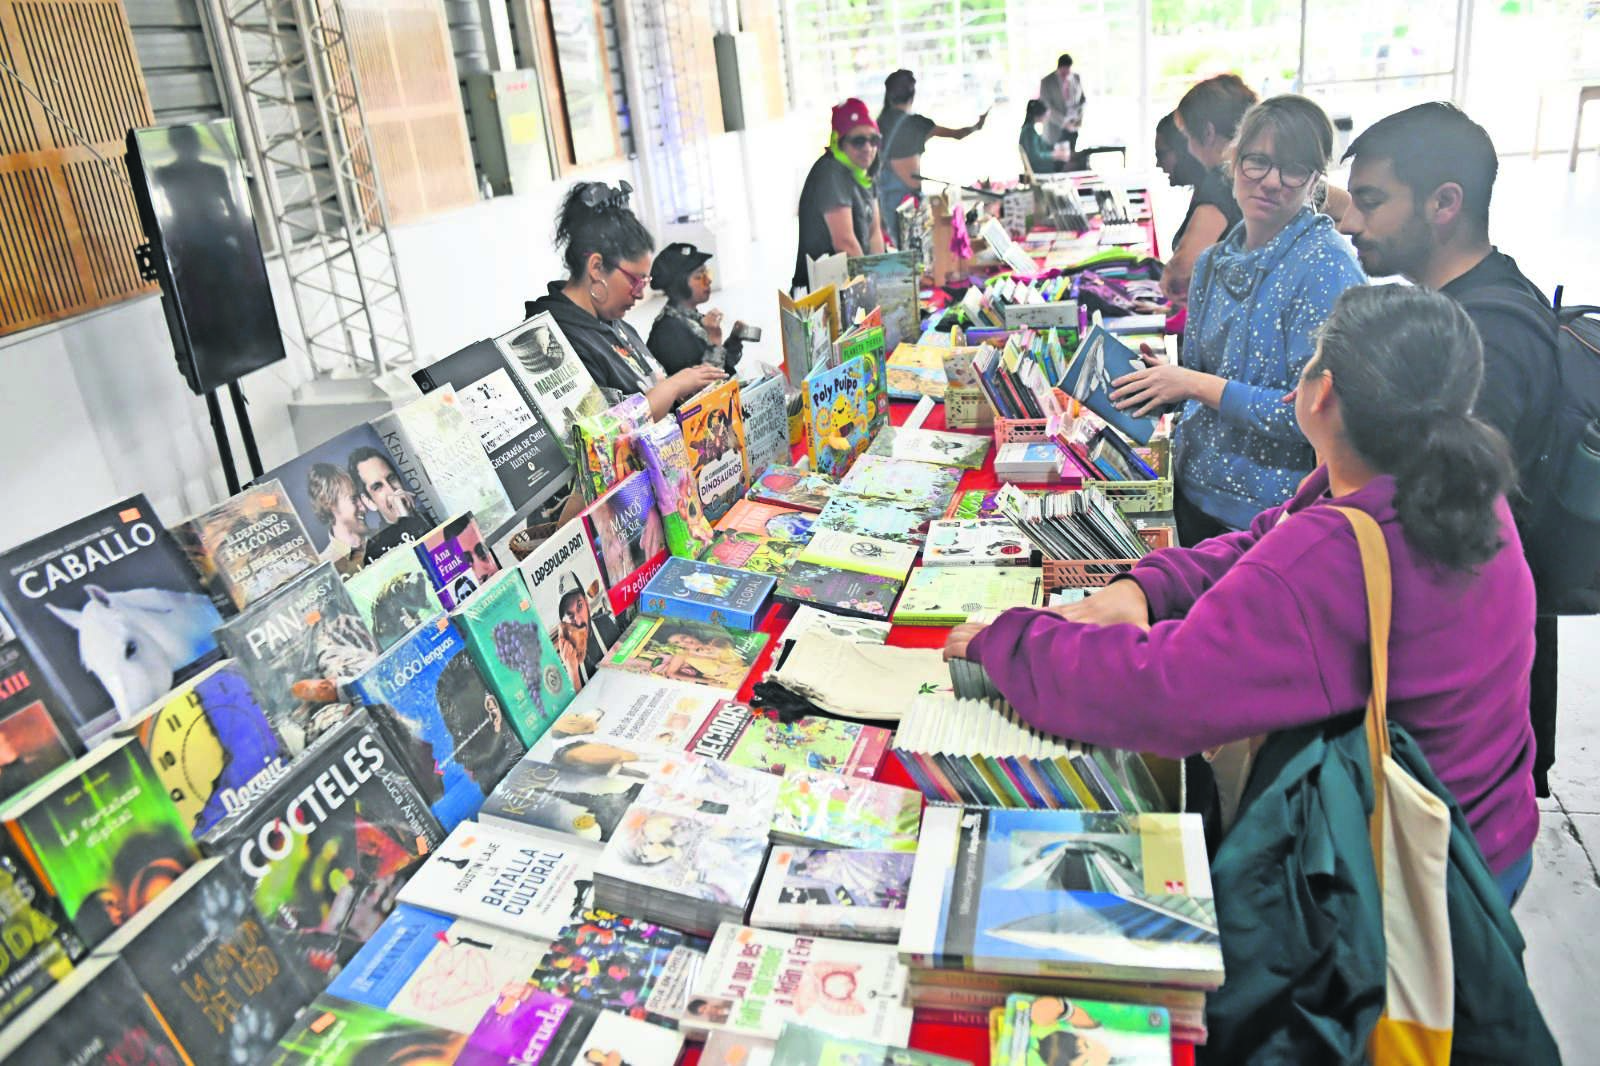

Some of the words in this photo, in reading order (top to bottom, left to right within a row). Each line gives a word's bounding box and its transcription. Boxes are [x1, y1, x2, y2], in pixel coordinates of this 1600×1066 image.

[534, 360, 581, 396] MARAVILLAS
[813, 383, 833, 407] Poly
[834, 376, 858, 394] Pulpo
[383, 431, 408, 467] KEN
[700, 460, 742, 497] DINOSAURIOS
[223, 513, 279, 548] ILDEFONSO
[609, 496, 643, 537] MANOS
[224, 519, 291, 563] FALCONES
[433, 548, 449, 566] Ana
[18, 522, 156, 599] CABALLO
[438, 554, 463, 578] Frank
[735, 576, 762, 608] FLORAL
[246, 606, 304, 661] PAN
[421, 636, 455, 667] lenguas
[239, 734, 385, 879] COCTELES
[481, 847, 540, 908] BATALLA
[503, 851, 566, 916] CULTURAL
